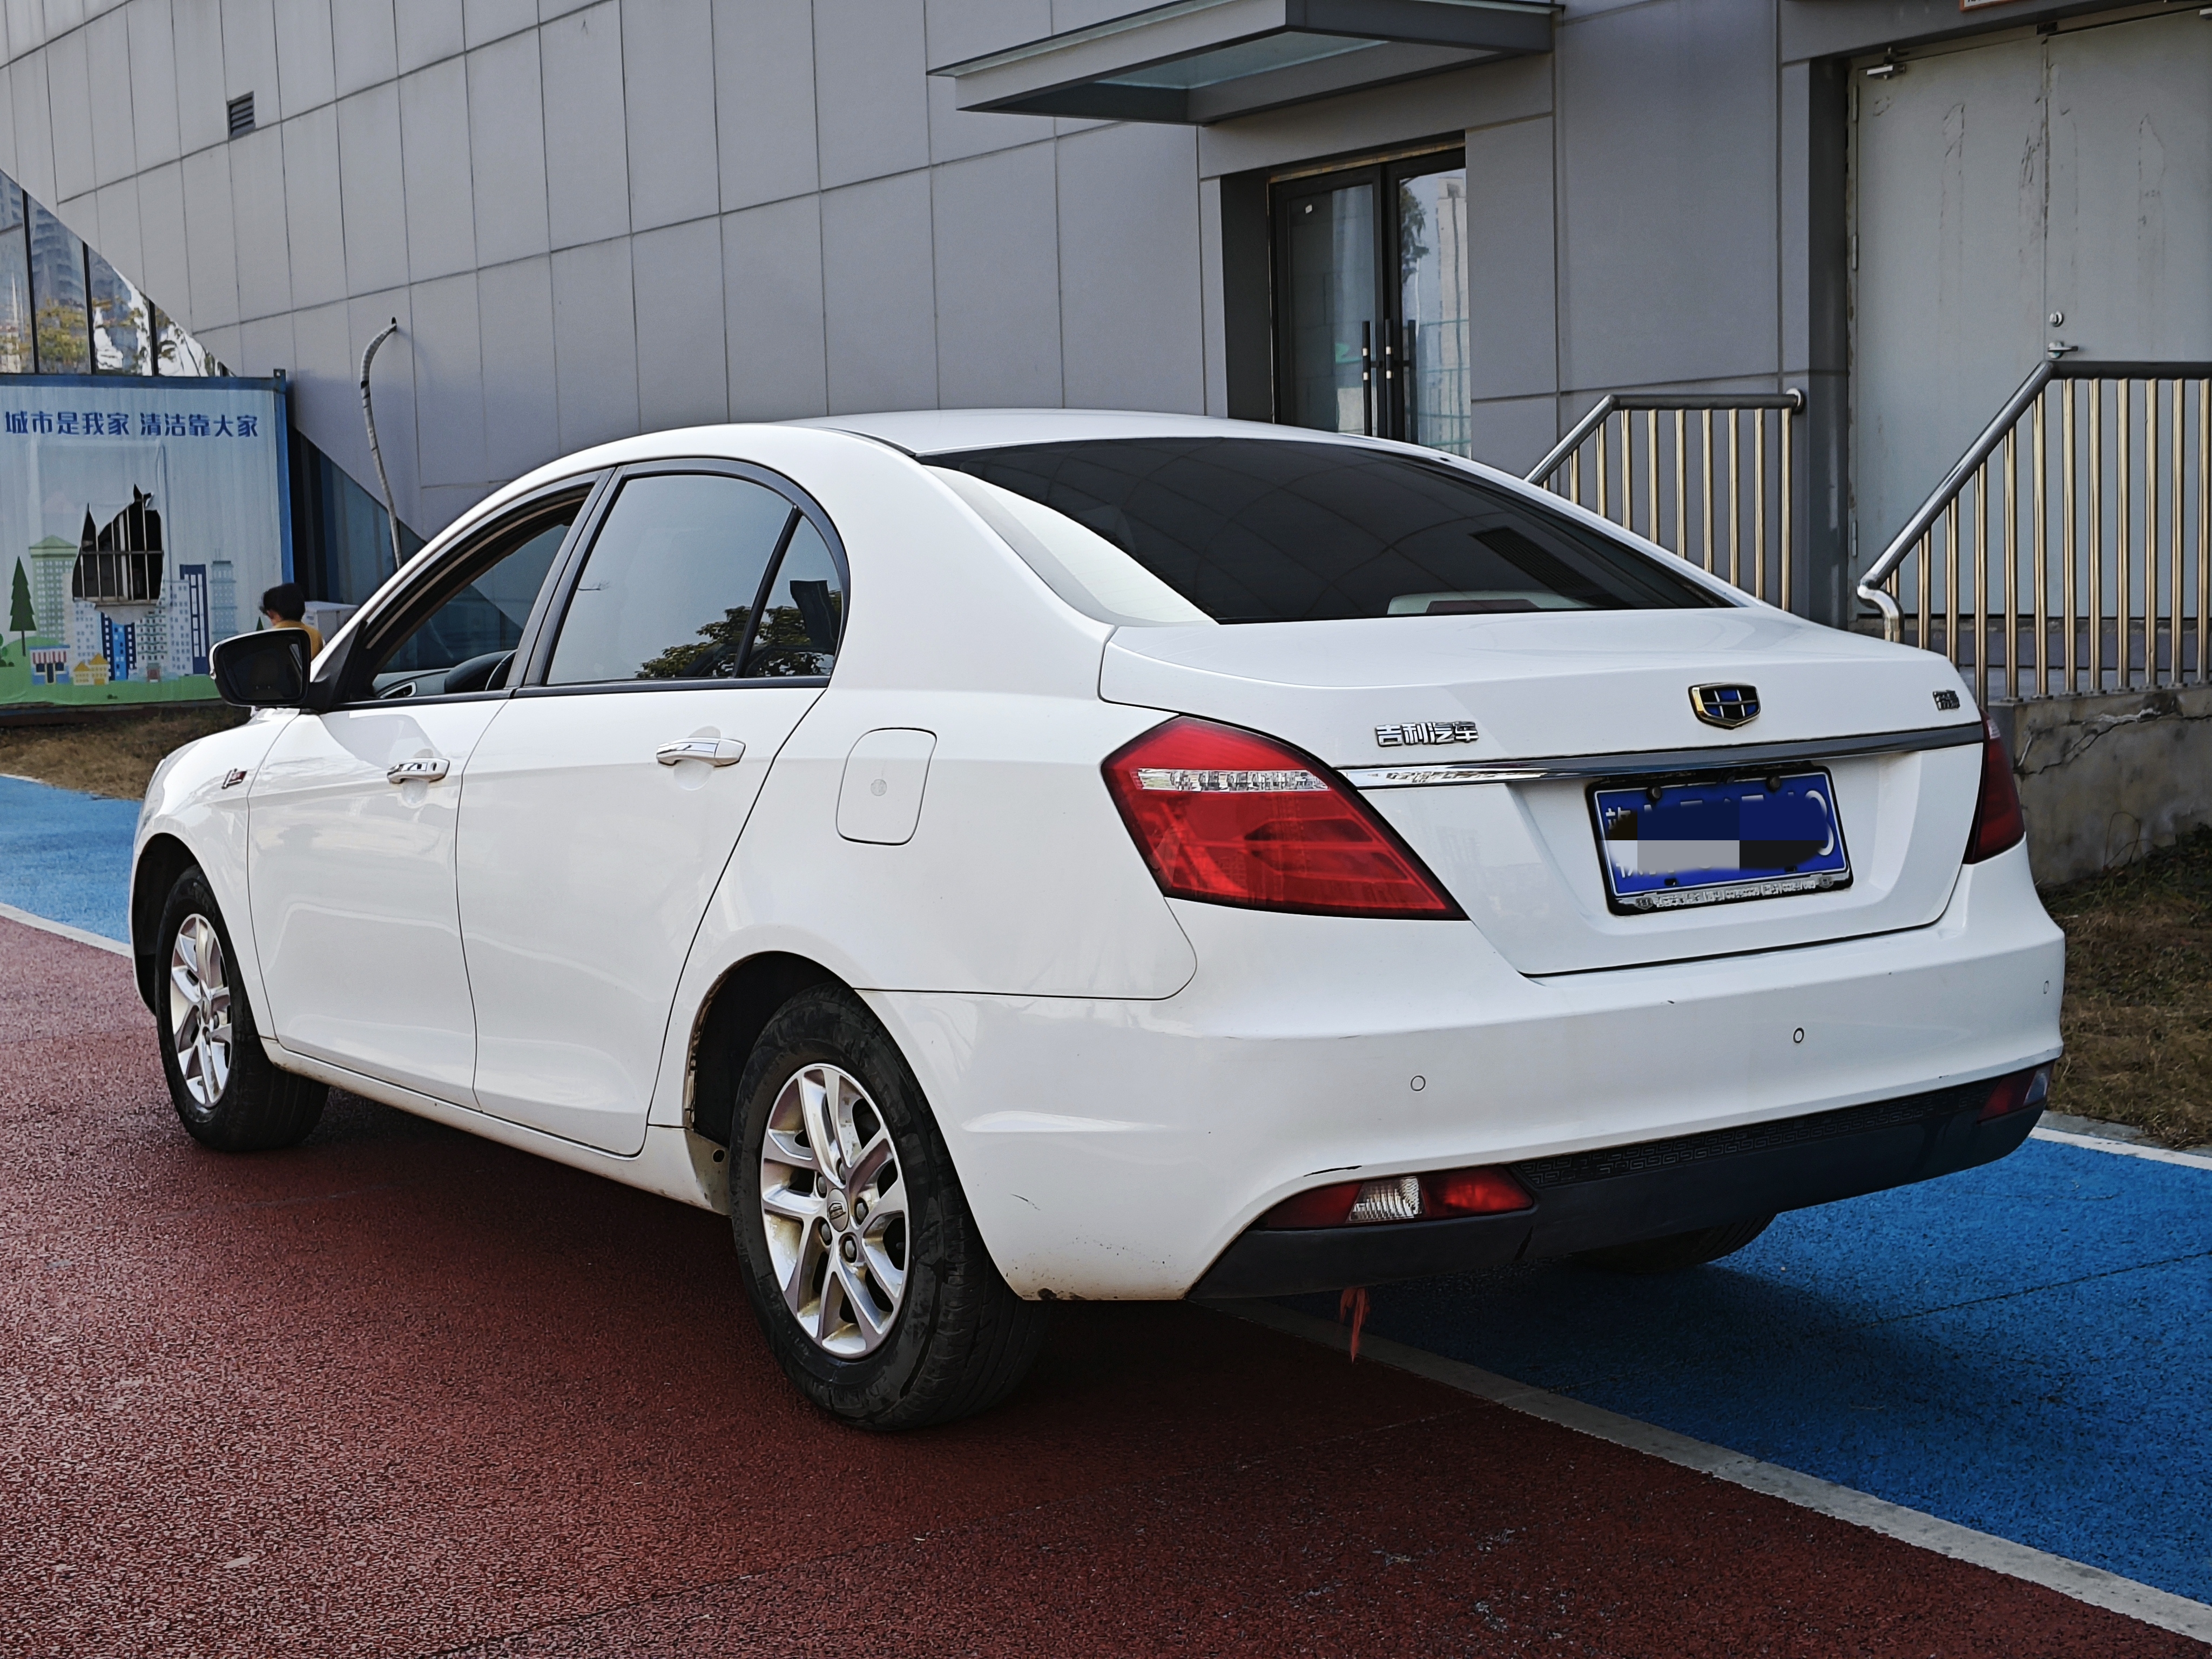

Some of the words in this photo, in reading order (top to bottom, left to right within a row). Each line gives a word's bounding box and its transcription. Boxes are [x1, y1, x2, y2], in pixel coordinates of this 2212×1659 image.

[5, 410, 129, 435] 城市是我家
[140, 413, 258, 437] 清洁靠大家
[1376, 721, 1479, 746] 吉利汽车
